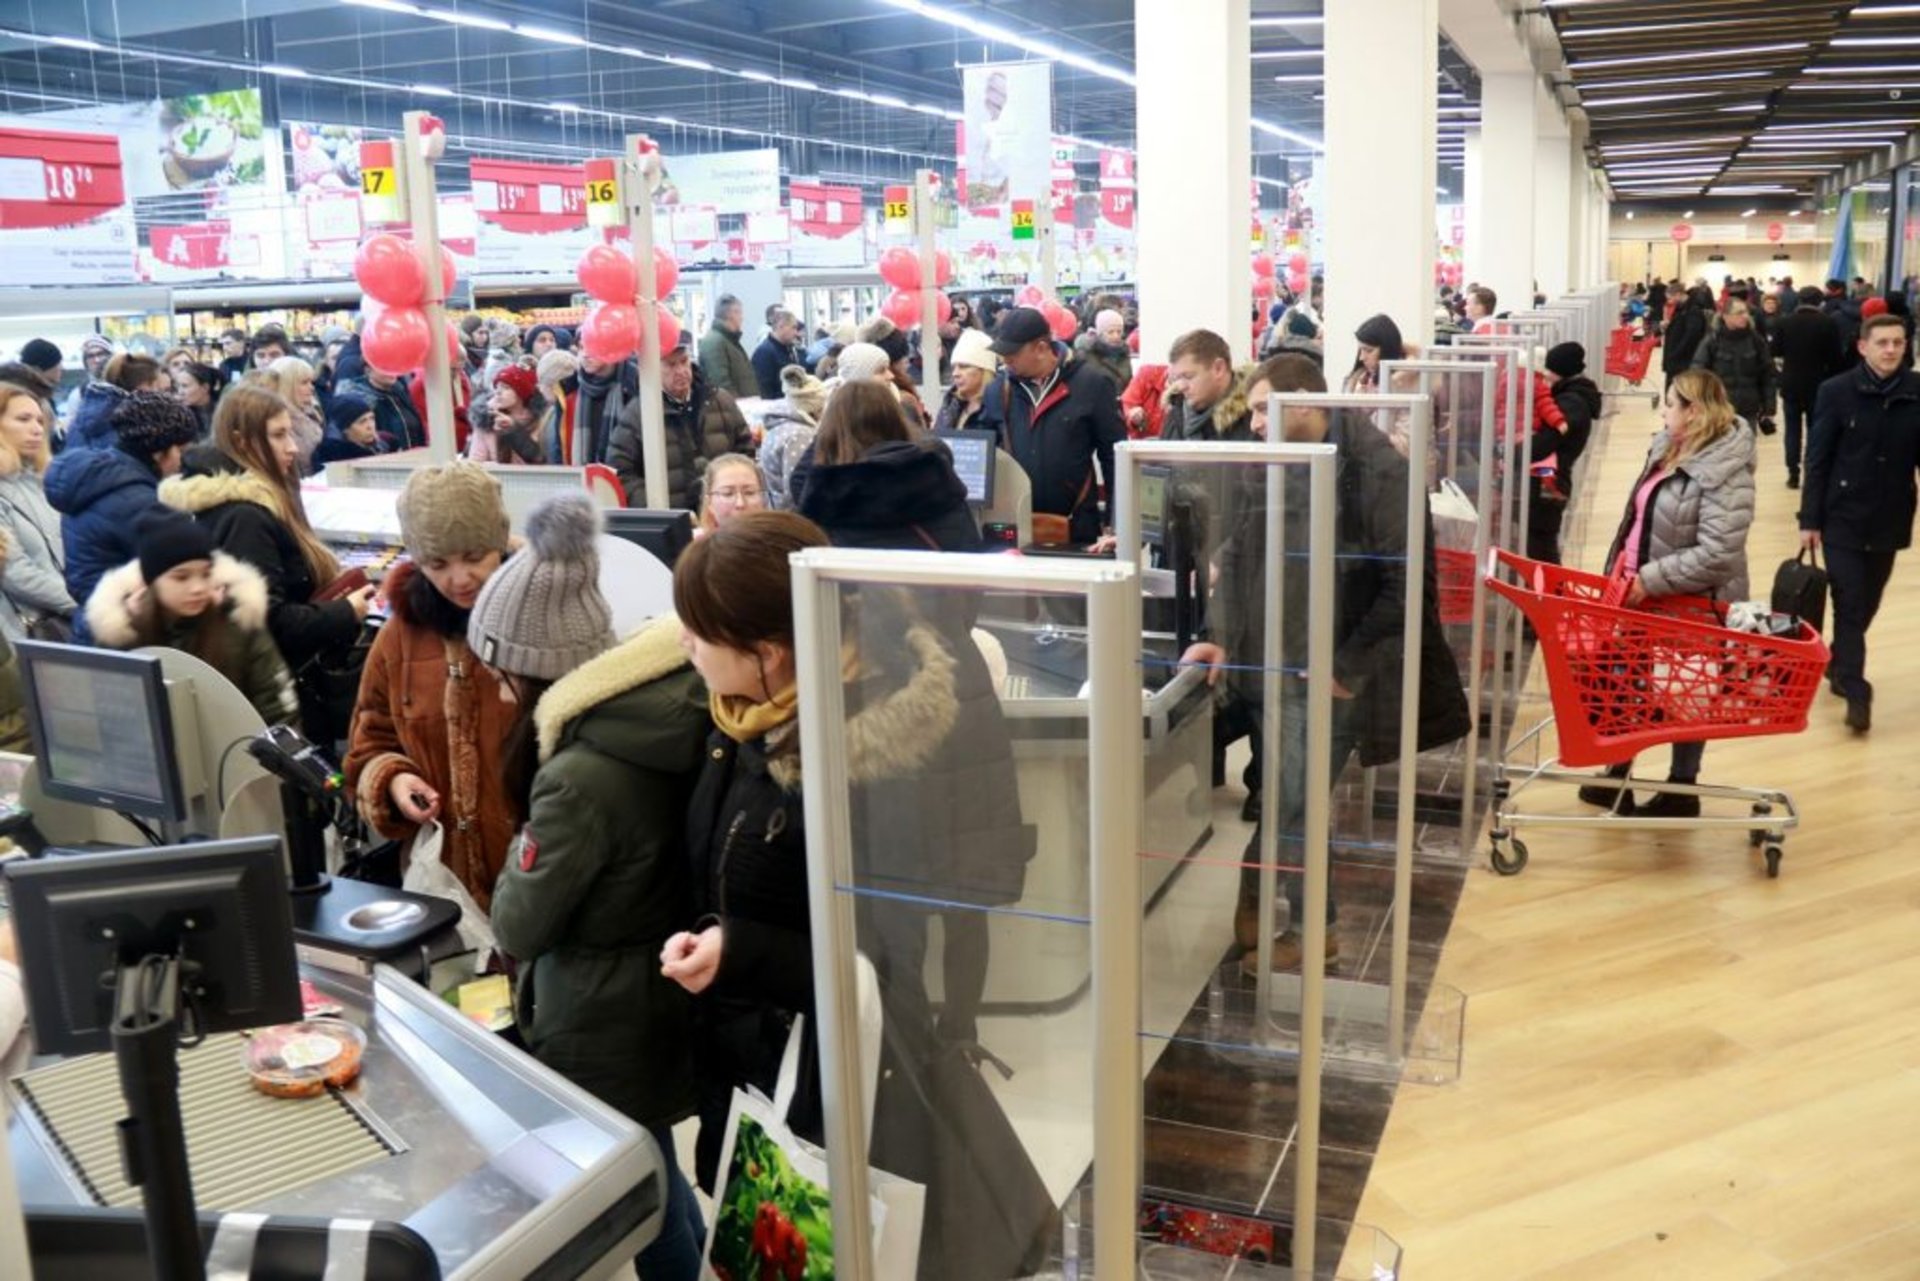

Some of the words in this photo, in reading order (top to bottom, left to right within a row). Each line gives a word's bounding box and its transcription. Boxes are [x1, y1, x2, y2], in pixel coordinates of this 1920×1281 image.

[361, 170, 385, 194] 17
[588, 183, 614, 202] 16
[888, 203, 907, 217] 15
[1016, 213, 1032, 225] 14
